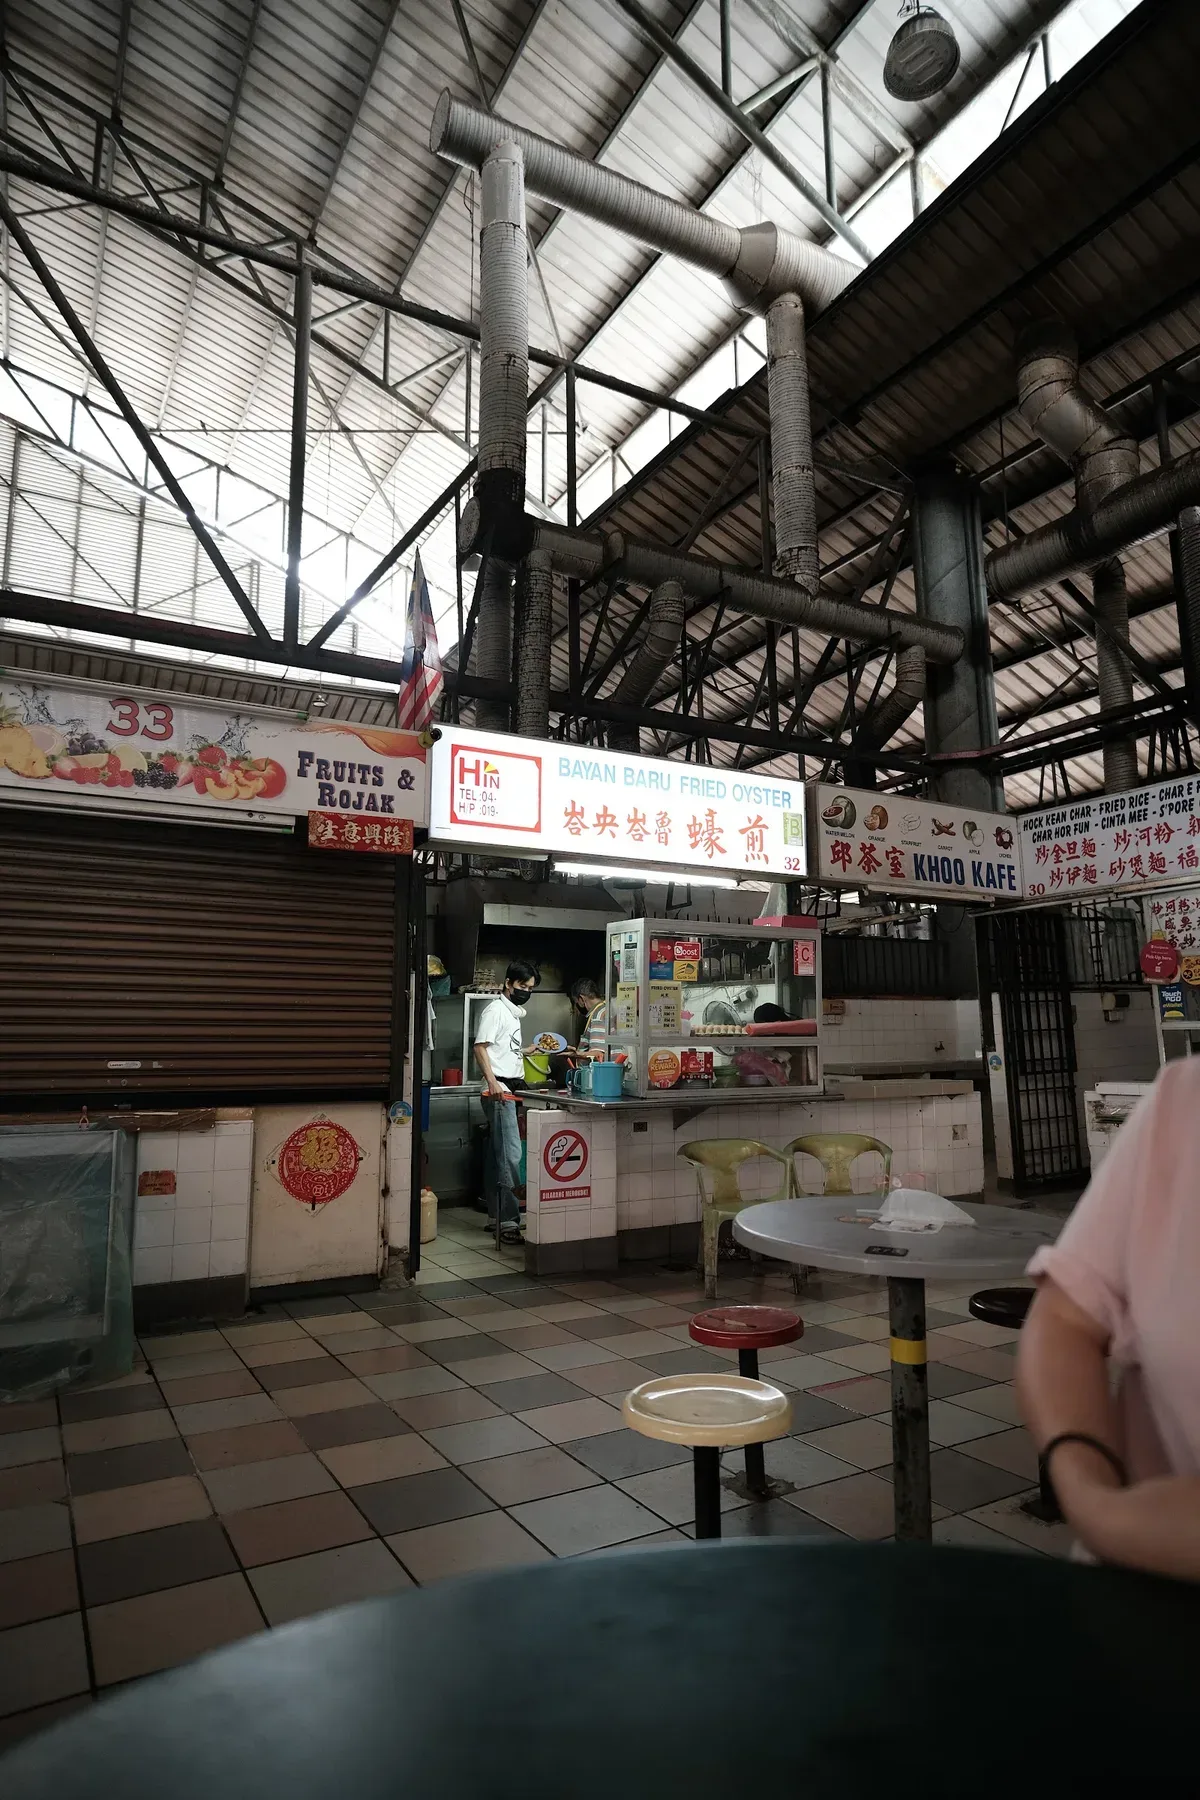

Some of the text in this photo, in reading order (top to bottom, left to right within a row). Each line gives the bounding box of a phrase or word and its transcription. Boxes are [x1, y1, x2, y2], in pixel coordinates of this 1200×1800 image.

[106, 698, 174, 741] 33
[297, 750, 415, 791] FRUITS &
[558, 757, 791, 809] BAYAN BARU FRIED OYSTER
[317, 781, 396, 814] ROJAK
[459, 788, 477, 801] TEL
[1023, 817, 1043, 832] HOCK
[1045, 812, 1067, 827] KEAN
[1099, 798, 1126, 816] FRIED
[1128, 791, 1150, 809] RICE
[1159, 784, 1184, 802] CHAR
[1186, 781, 1193, 796] E
[316, 819, 405, 847] 生意興隆
[790, 818, 801, 837] B
[1032, 797, 1195, 843] CHAR HOR FUN CINTA MEE S'PORE
[867, 835, 886, 843] ORANGE
[784, 857, 801, 871] 32
[830, 839, 906, 878] 邱茶室
[913, 853, 1017, 891] KHOO KAFE
[1028, 883, 1046, 897] 30
[801, 946, 810, 962] C
